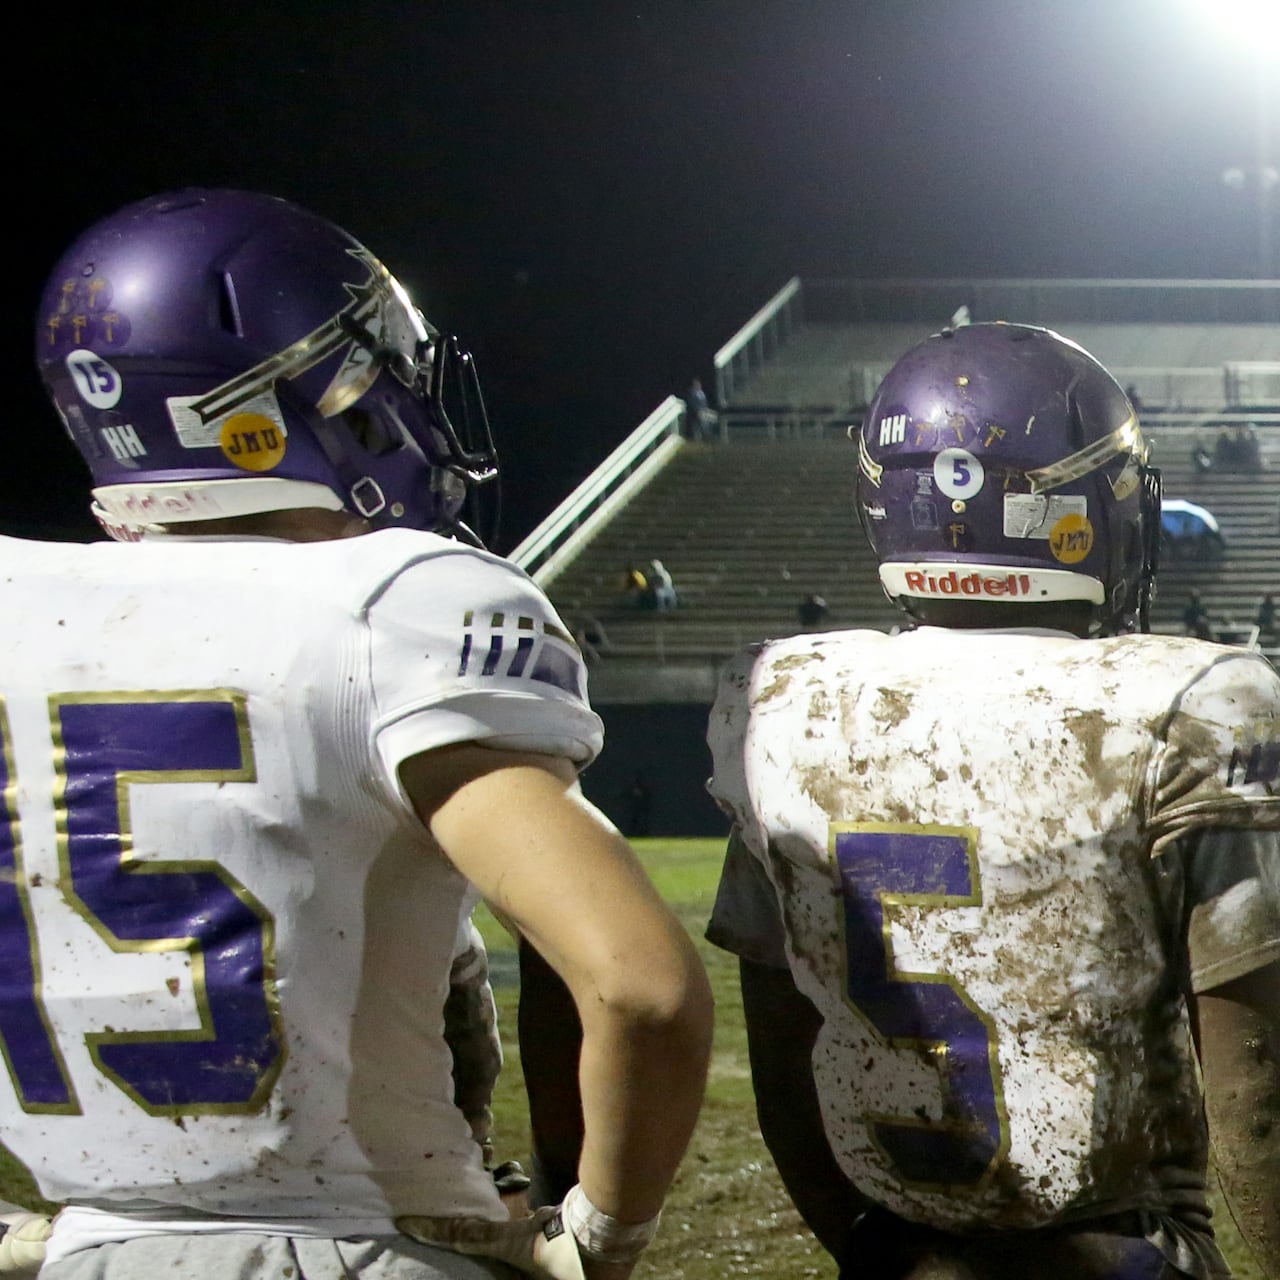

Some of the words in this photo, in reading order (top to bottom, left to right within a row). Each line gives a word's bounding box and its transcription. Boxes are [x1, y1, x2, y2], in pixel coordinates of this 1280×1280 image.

[73, 362, 116, 394] 15
[102, 423, 147, 460] HH
[228, 427, 278, 456] JMU
[879, 414, 907, 447] HH
[952, 458, 971, 487] 5
[904, 570, 1031, 597] Riddell
[828, 821, 1009, 1192] 5
